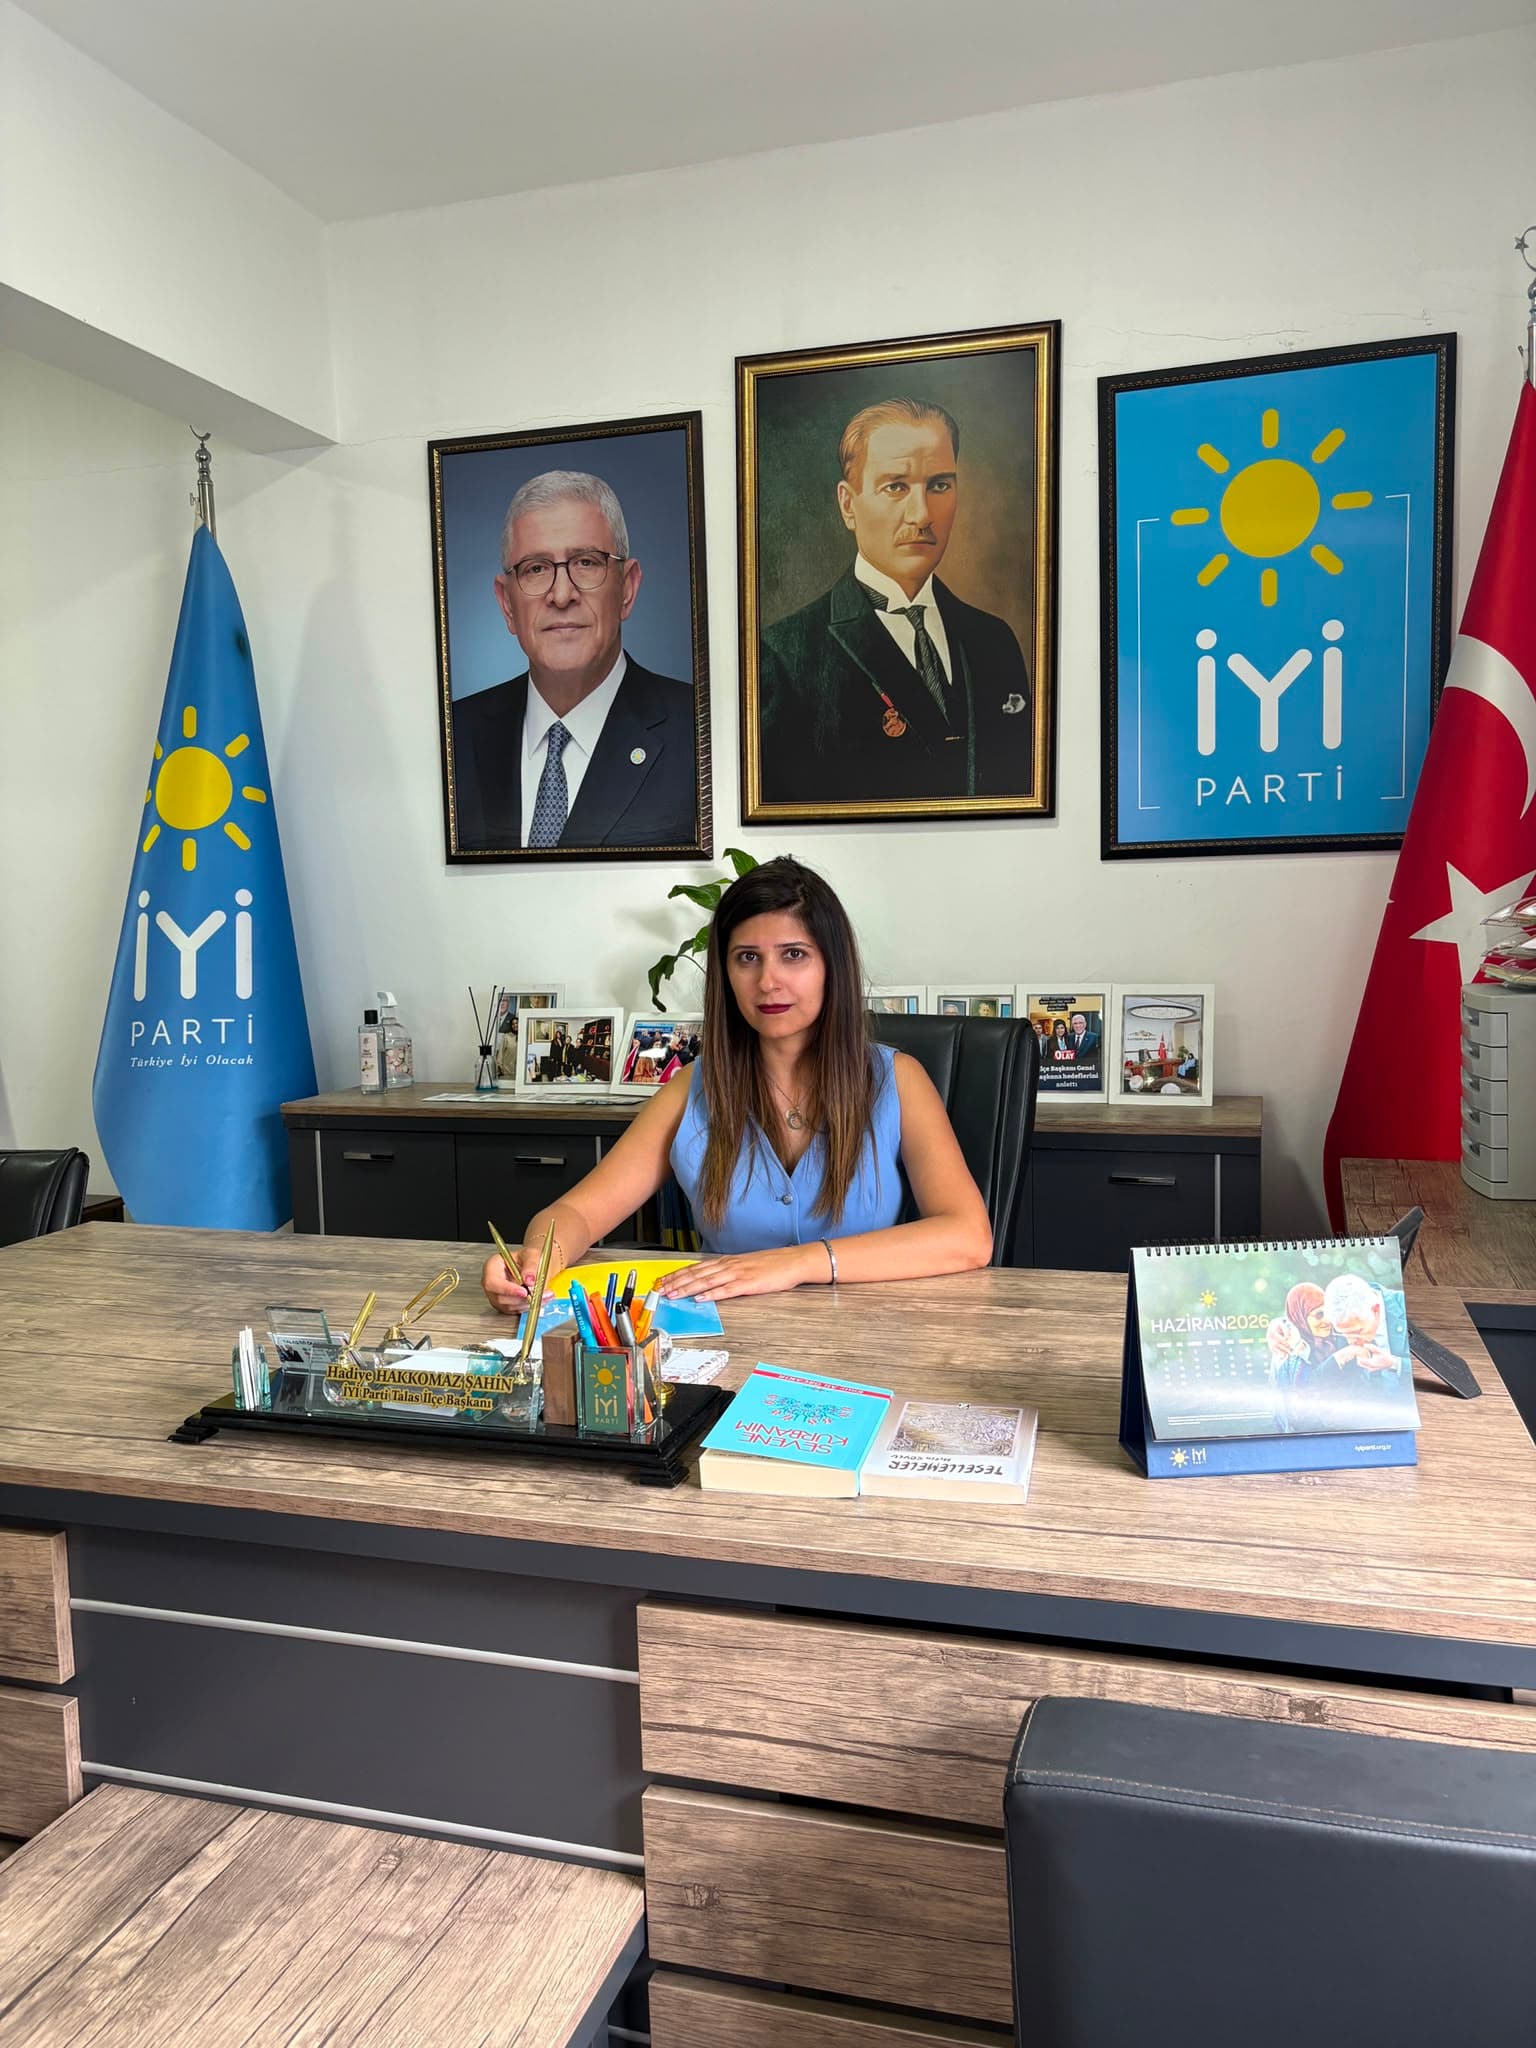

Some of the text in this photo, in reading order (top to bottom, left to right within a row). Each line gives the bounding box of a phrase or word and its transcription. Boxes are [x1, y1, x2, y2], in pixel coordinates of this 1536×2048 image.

[1195, 619, 1345, 756] İYİ
[1197, 764, 1343, 807] PARTİ
[134, 888, 253, 1001] İYİ
[131, 1013, 253, 1047] PARTİ
[130, 1053, 254, 1068] Türkiye İyi Olacak
[327, 1365, 514, 1394] Hadiye HAKKOMAZ ŞAHİN
[342, 1384, 493, 1411] İYİ Parti Talas İlçe Başkanı
[594, 1394, 618, 1417] İYİ
[735, 1420, 848, 1446] KURBANIM
[738, 1432, 831, 1454] SEVENE
[888, 1460, 1003, 1475] TESELLEMELER
